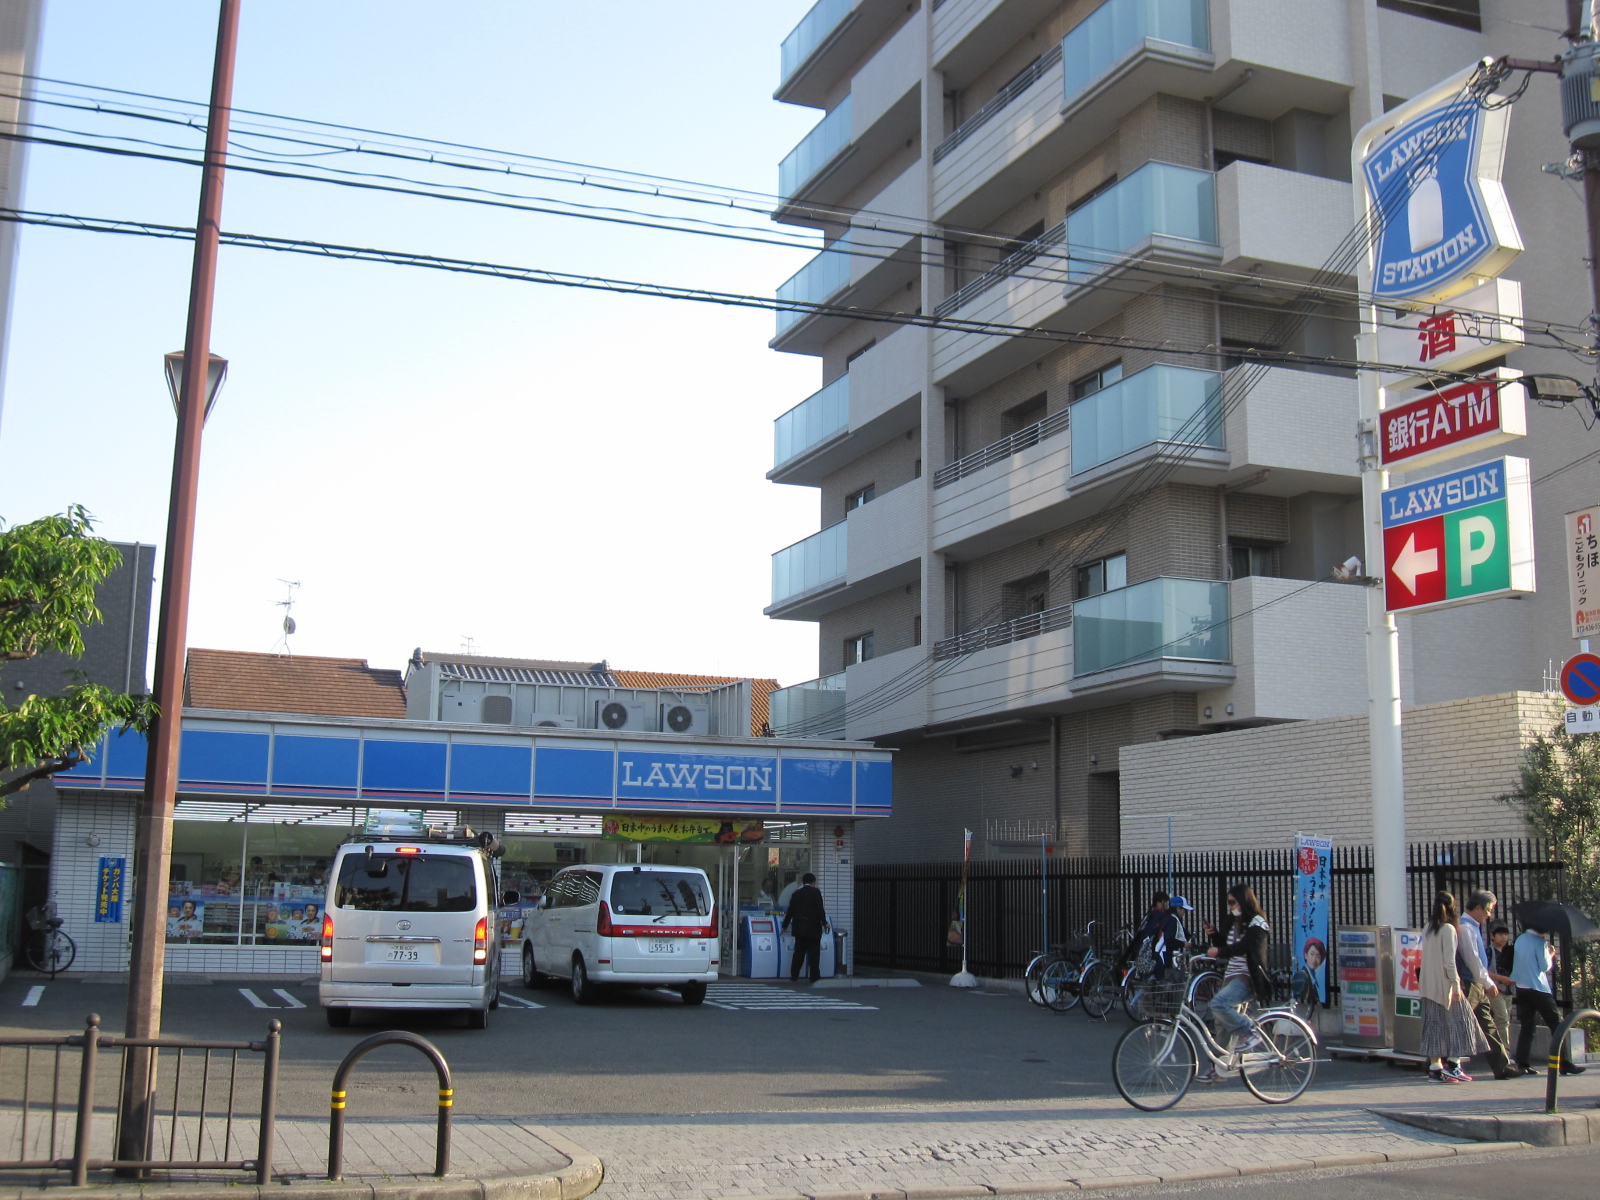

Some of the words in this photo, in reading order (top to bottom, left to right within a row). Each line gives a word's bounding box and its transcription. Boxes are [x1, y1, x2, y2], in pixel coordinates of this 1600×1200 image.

[1374, 115, 1469, 183] LAWSON
[1382, 223, 1477, 285] STATION
[1418, 310, 1456, 362] 酒
[1388, 388, 1492, 453] 銀行ATM
[1389, 468, 1498, 520] LAWSON
[1459, 515, 1496, 587] P
[1575, 536, 1587, 605] こどもクリニック
[1586, 534, 1599, 568] ちほ
[1567, 710, 1600, 723] 自動
[622, 761, 772, 791] LAWSON
[1300, 838, 1330, 847] LAWSON
[1319, 856, 1327, 900] 日本中の
[393, 950, 418, 960] 77-39
[1410, 999, 1420, 1016] P
